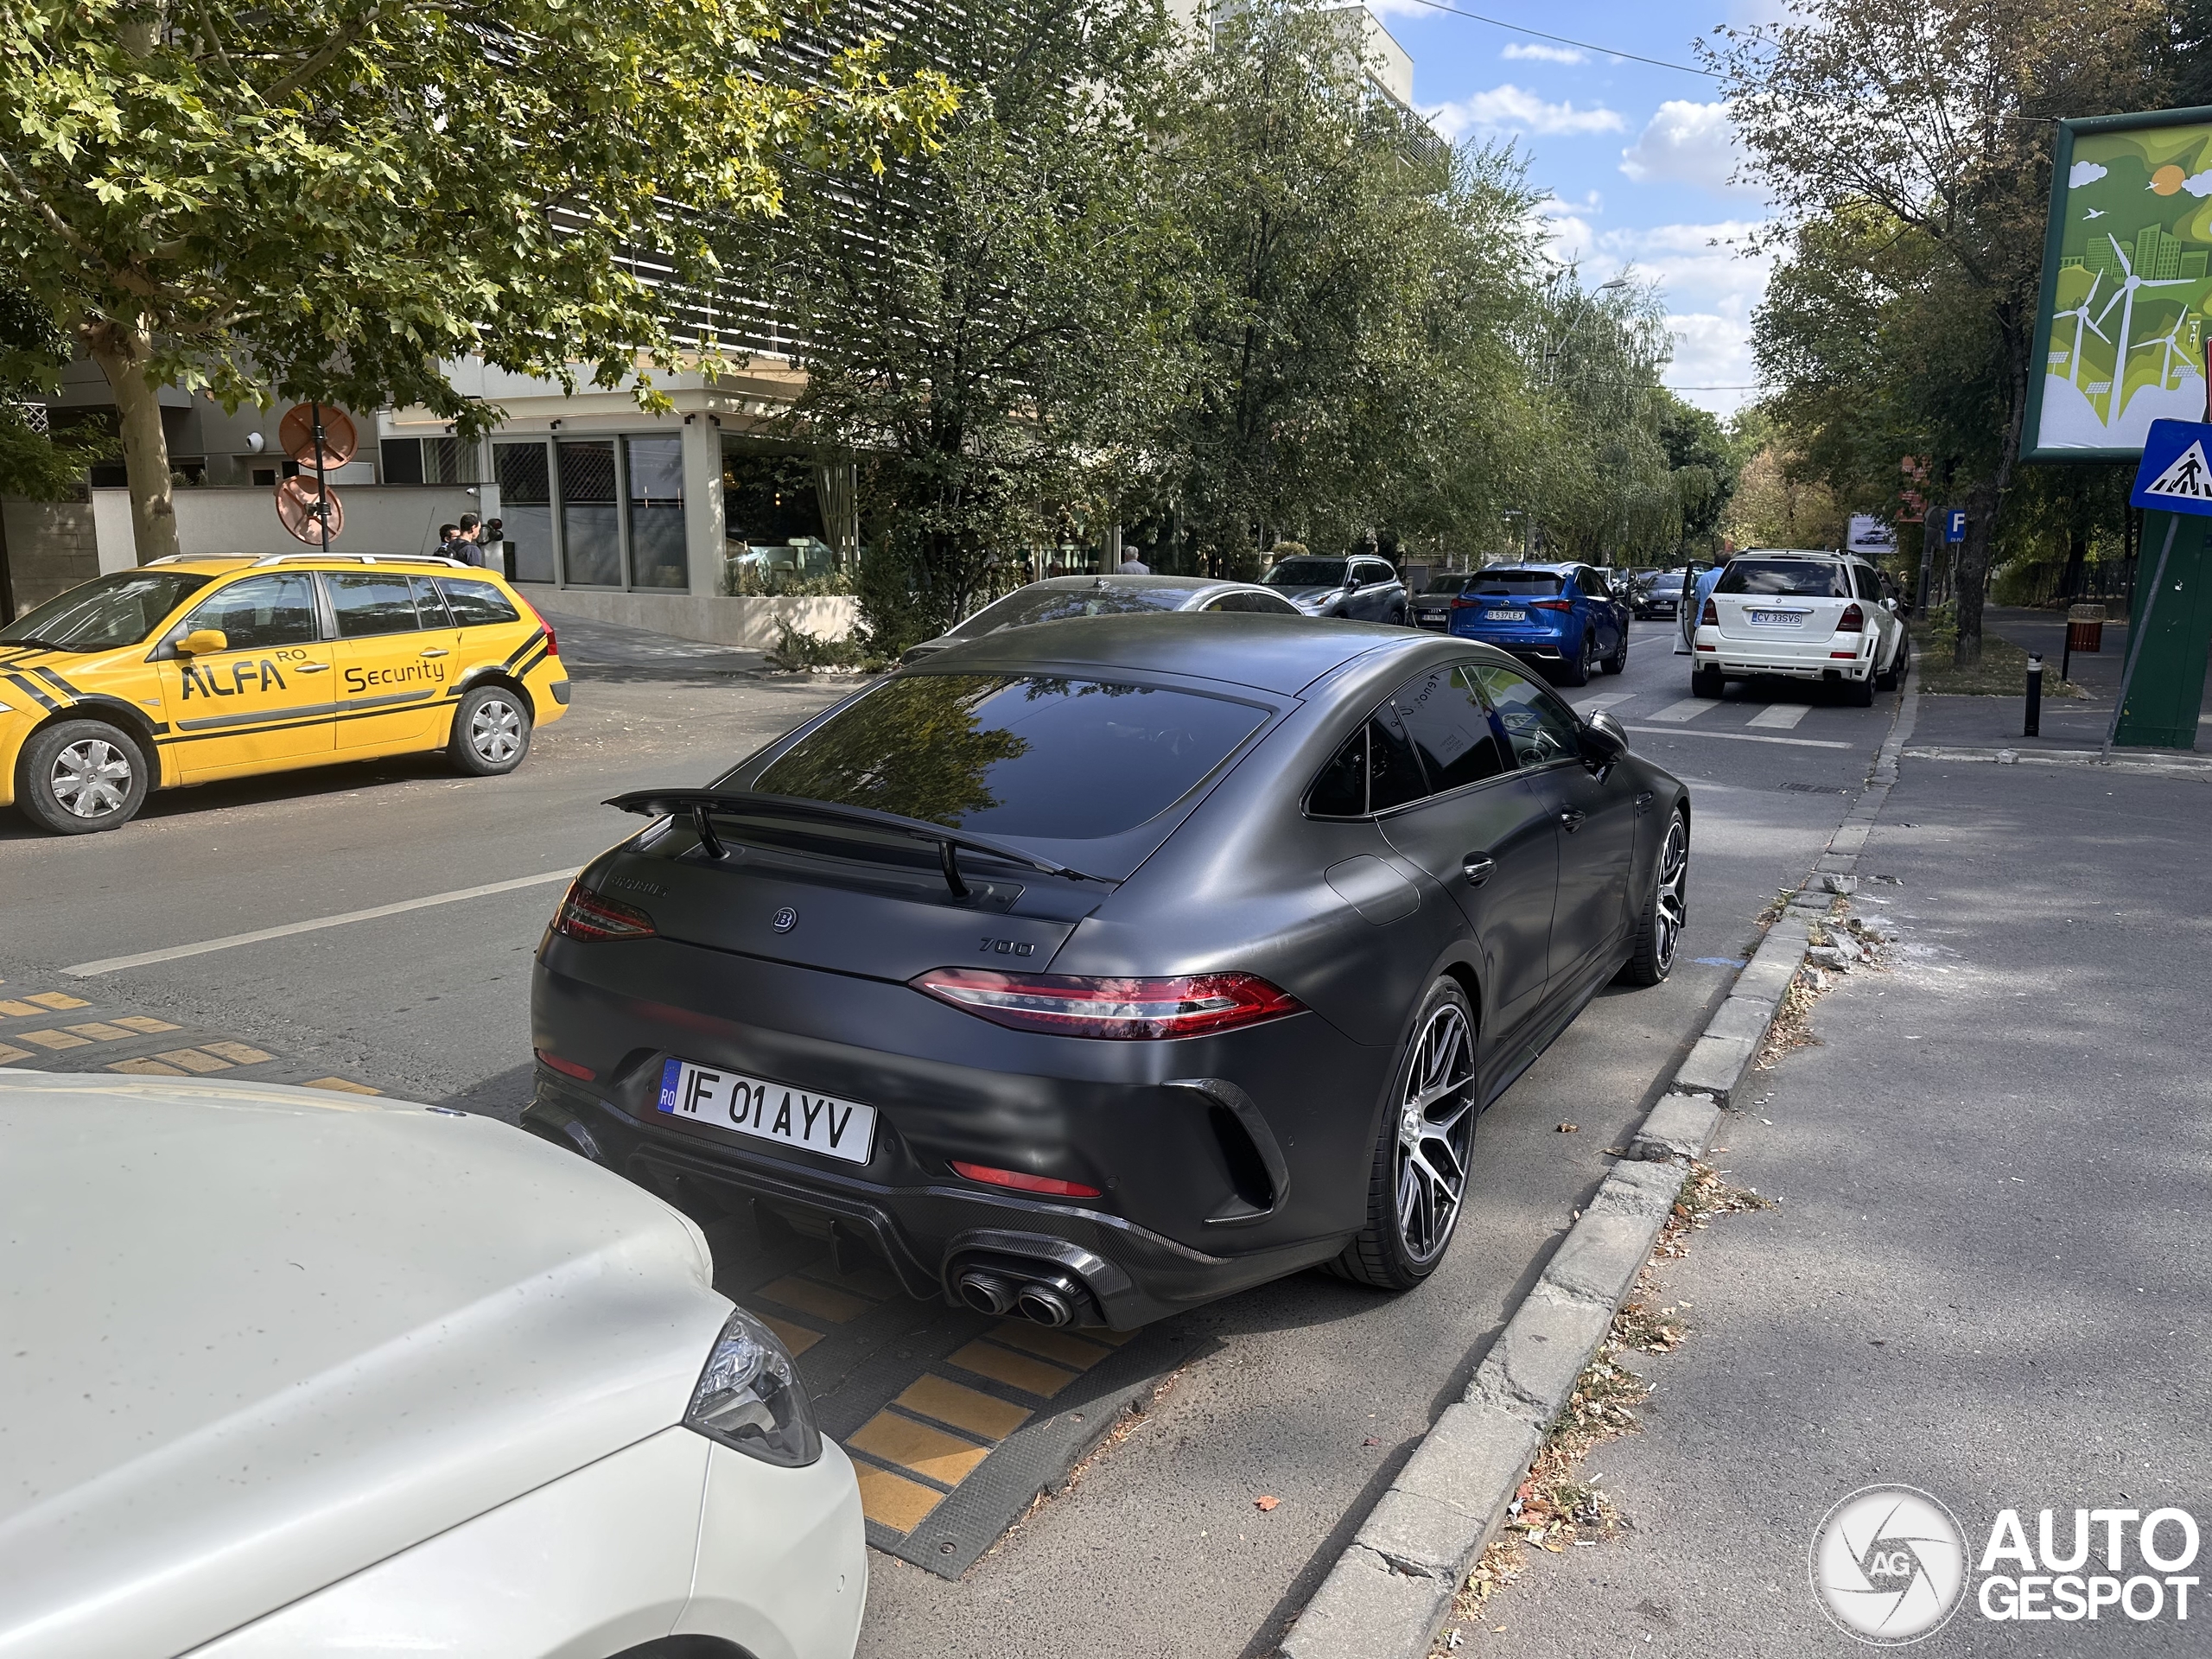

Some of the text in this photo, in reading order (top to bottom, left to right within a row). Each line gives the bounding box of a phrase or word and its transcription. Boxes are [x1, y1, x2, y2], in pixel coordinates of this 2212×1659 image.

[181, 648, 307, 701] ALFA RO
[345, 660, 445, 693] Security
[979, 937, 1036, 957] 700
[660, 1088, 676, 1107] RO
[683, 1069, 720, 1114] IF
